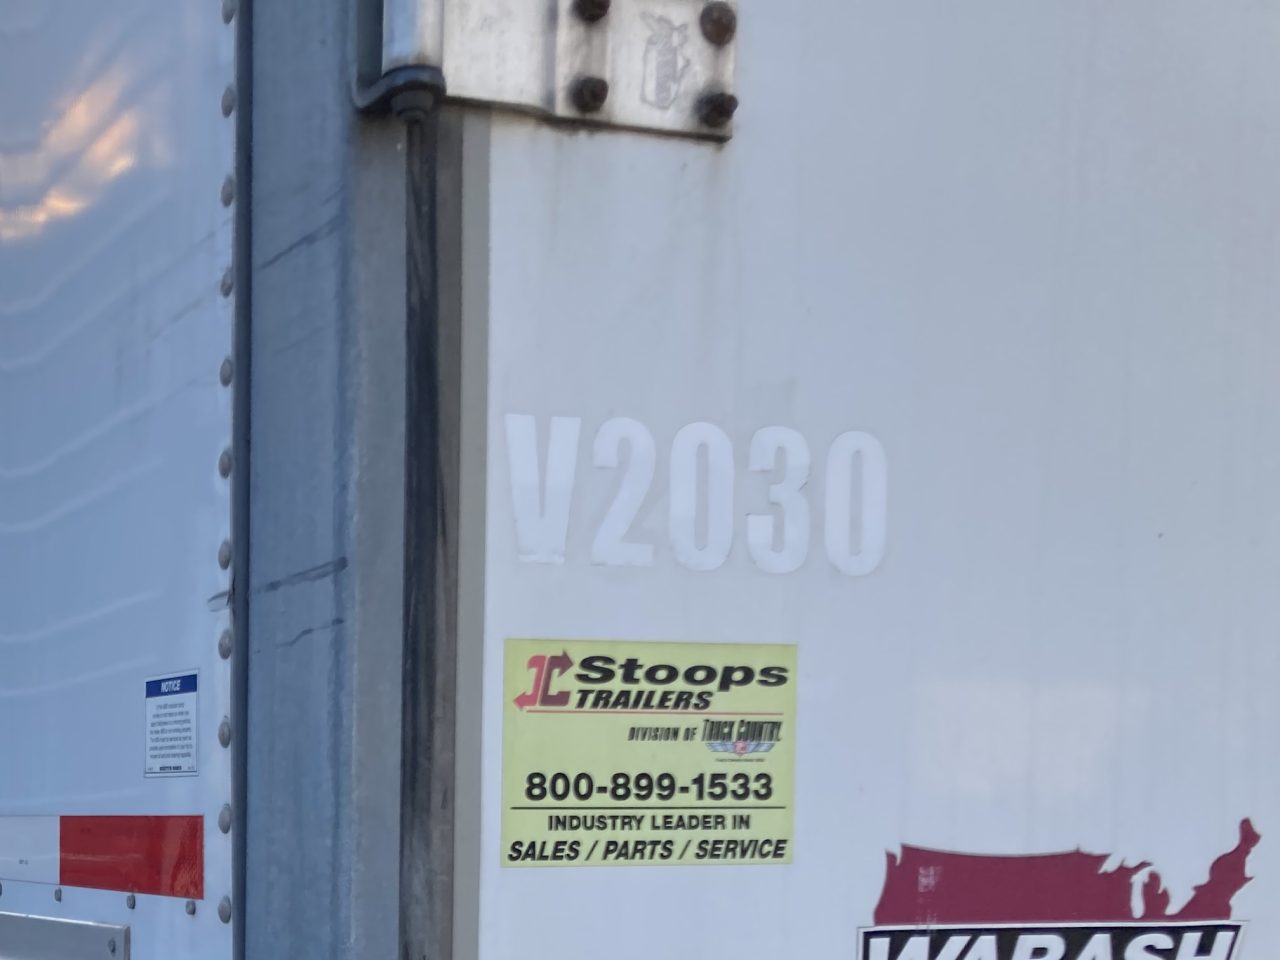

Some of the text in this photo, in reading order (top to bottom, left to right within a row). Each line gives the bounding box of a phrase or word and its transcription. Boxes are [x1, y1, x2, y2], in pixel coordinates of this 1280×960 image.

[505, 413, 887, 576] V2030
[575, 655, 789, 692] Stoops
[161, 680, 181, 693] NOTICE
[575, 689, 714, 710] TRAILERS
[628, 719, 783, 742] DIVISION OF TRUCK COUNTRY
[525, 772, 773, 801] 800-899-1533
[548, 814, 751, 831] INDUSTRY LEADER IN
[507, 840, 580, 862] SALES
[602, 839, 673, 860] PARTS
[694, 838, 788, 860] SERVICE
